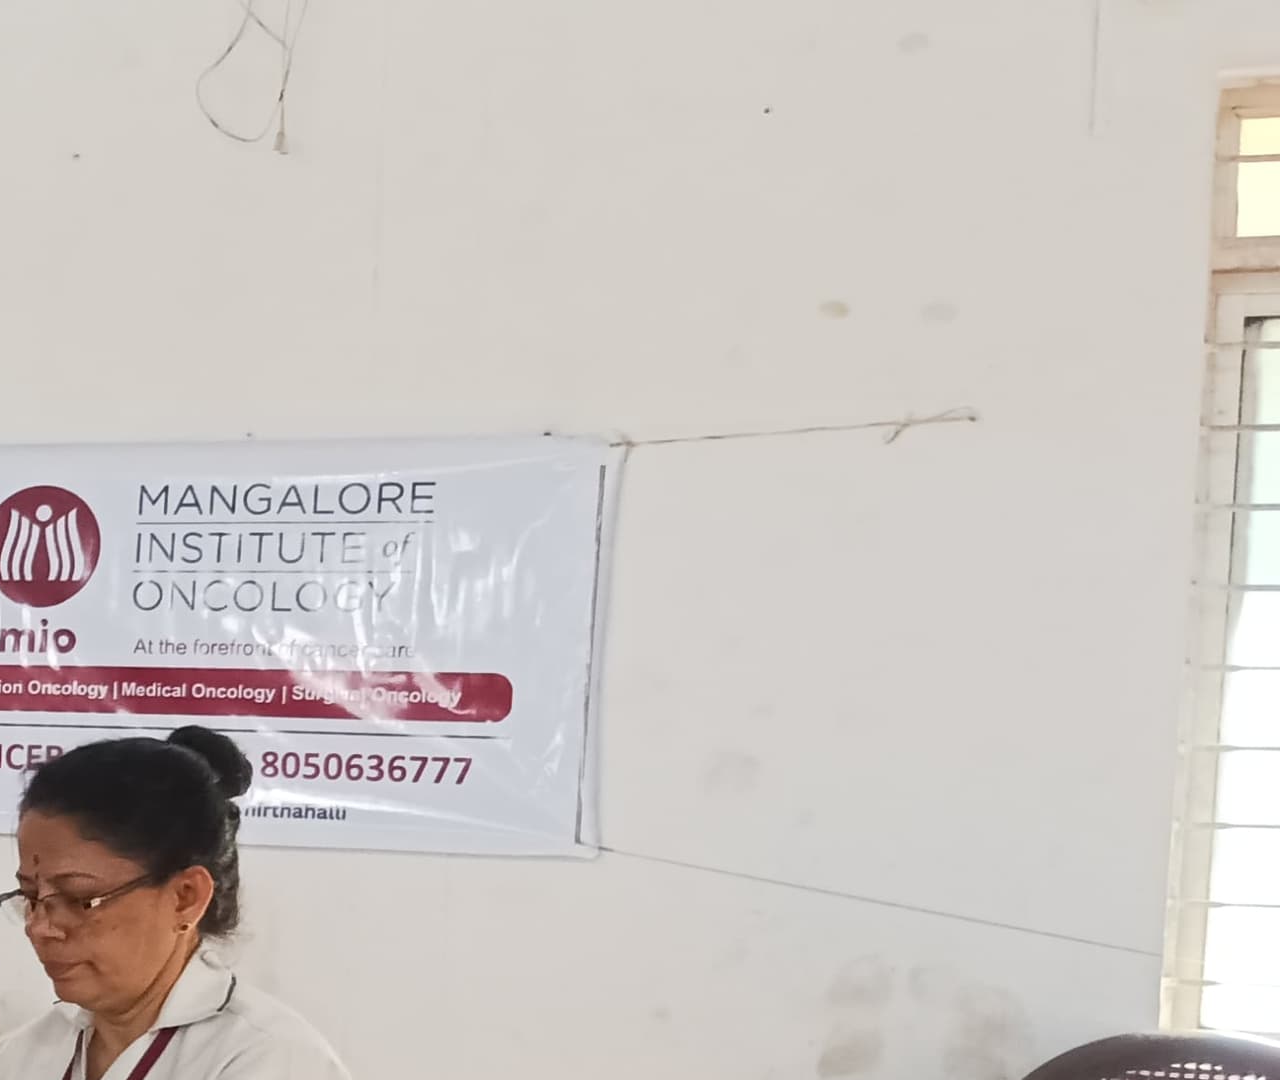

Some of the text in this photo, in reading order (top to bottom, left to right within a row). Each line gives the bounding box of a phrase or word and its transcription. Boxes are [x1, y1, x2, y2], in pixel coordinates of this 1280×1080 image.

[139, 481, 437, 516] MANGALORE
[135, 530, 417, 564] INSTITUTE of
[133, 579, 397, 613] ONCOLOGY
[133, 639, 153, 655] At
[159, 639, 187, 656] the
[27, 680, 108, 699] Oncology
[121, 682, 187, 698] Medical
[191, 683, 276, 704] Oncology
[371, 687, 462, 708] Oncology
[260, 751, 473, 785] 8050636777
